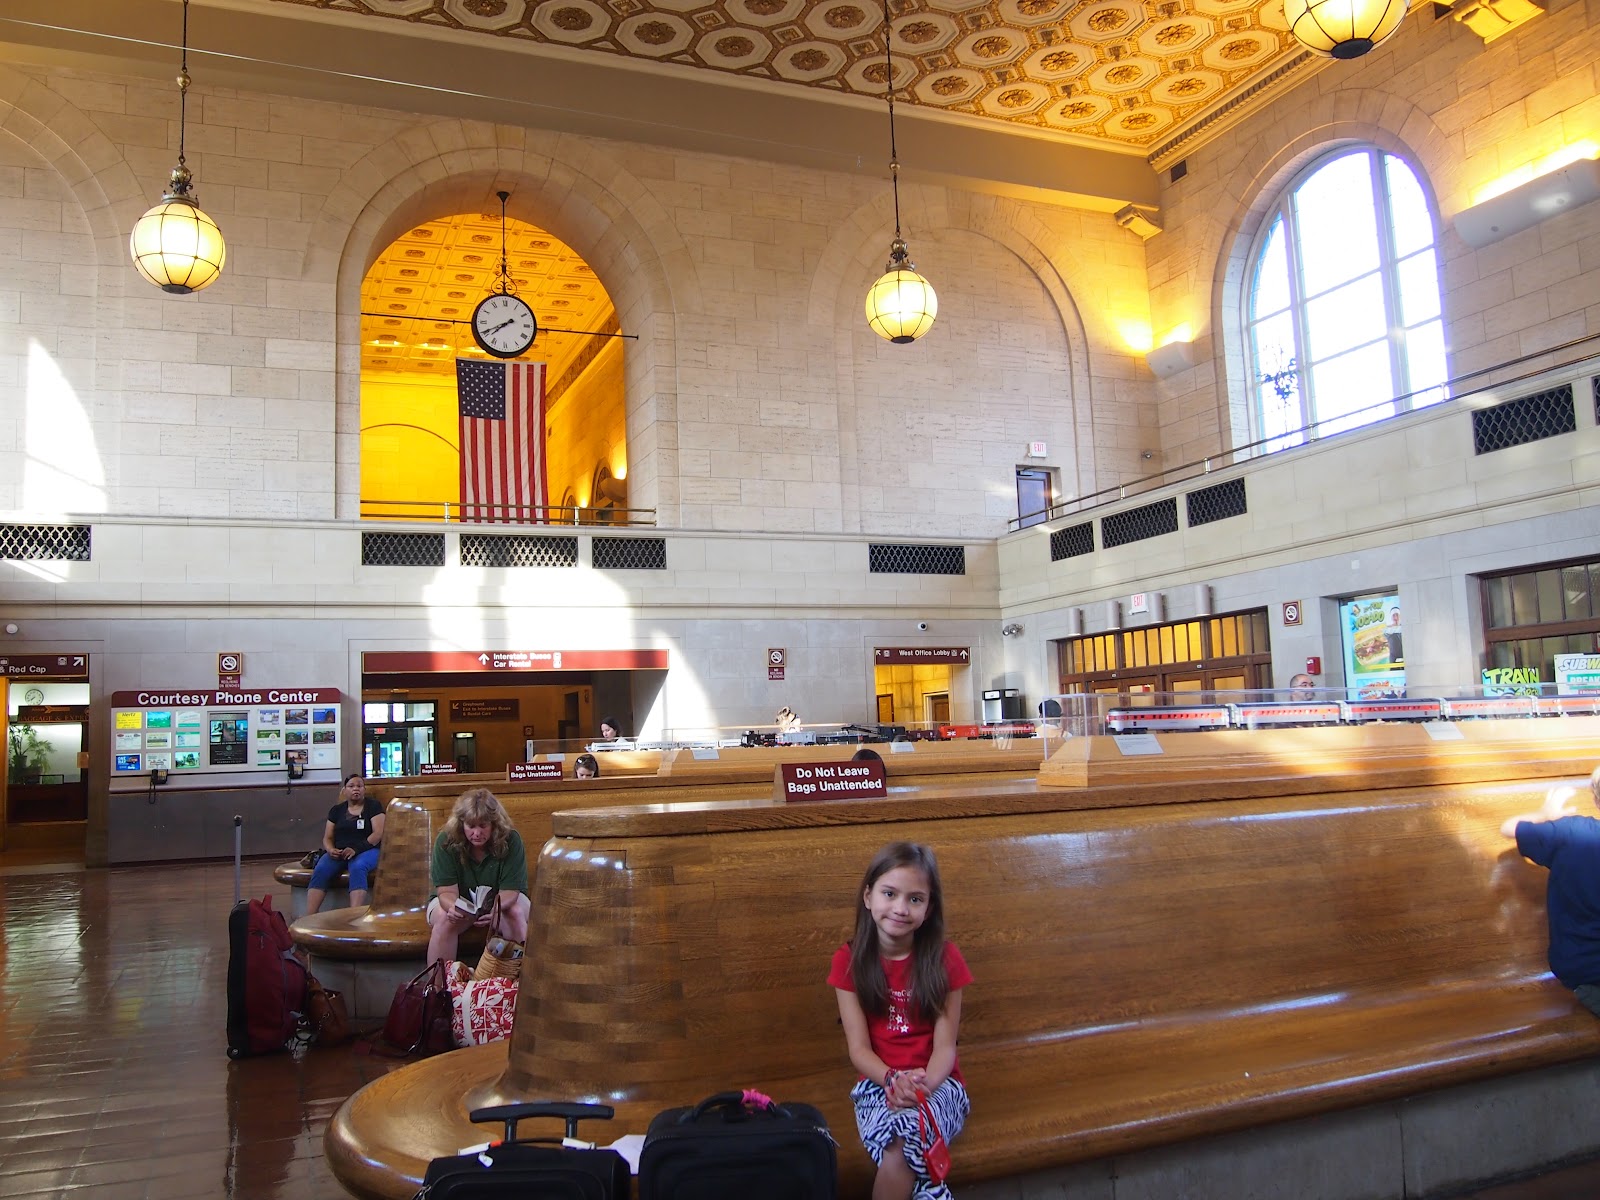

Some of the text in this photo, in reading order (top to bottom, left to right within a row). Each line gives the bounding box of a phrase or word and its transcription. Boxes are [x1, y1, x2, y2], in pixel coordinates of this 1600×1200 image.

[1034, 443, 1044, 452] EXIT
[1134, 595, 1143, 606] EXIT
[29, 665, 46, 674] Cap
[508, 660, 532, 668] Rental
[1483, 667, 1540, 691] TRAIN
[137, 690, 319, 706] Courtesy Phone Center
[527, 770, 561, 778] Unattended
[795, 765, 870, 779] Do Not Leave
[787, 778, 883, 795] Bags Unattended
